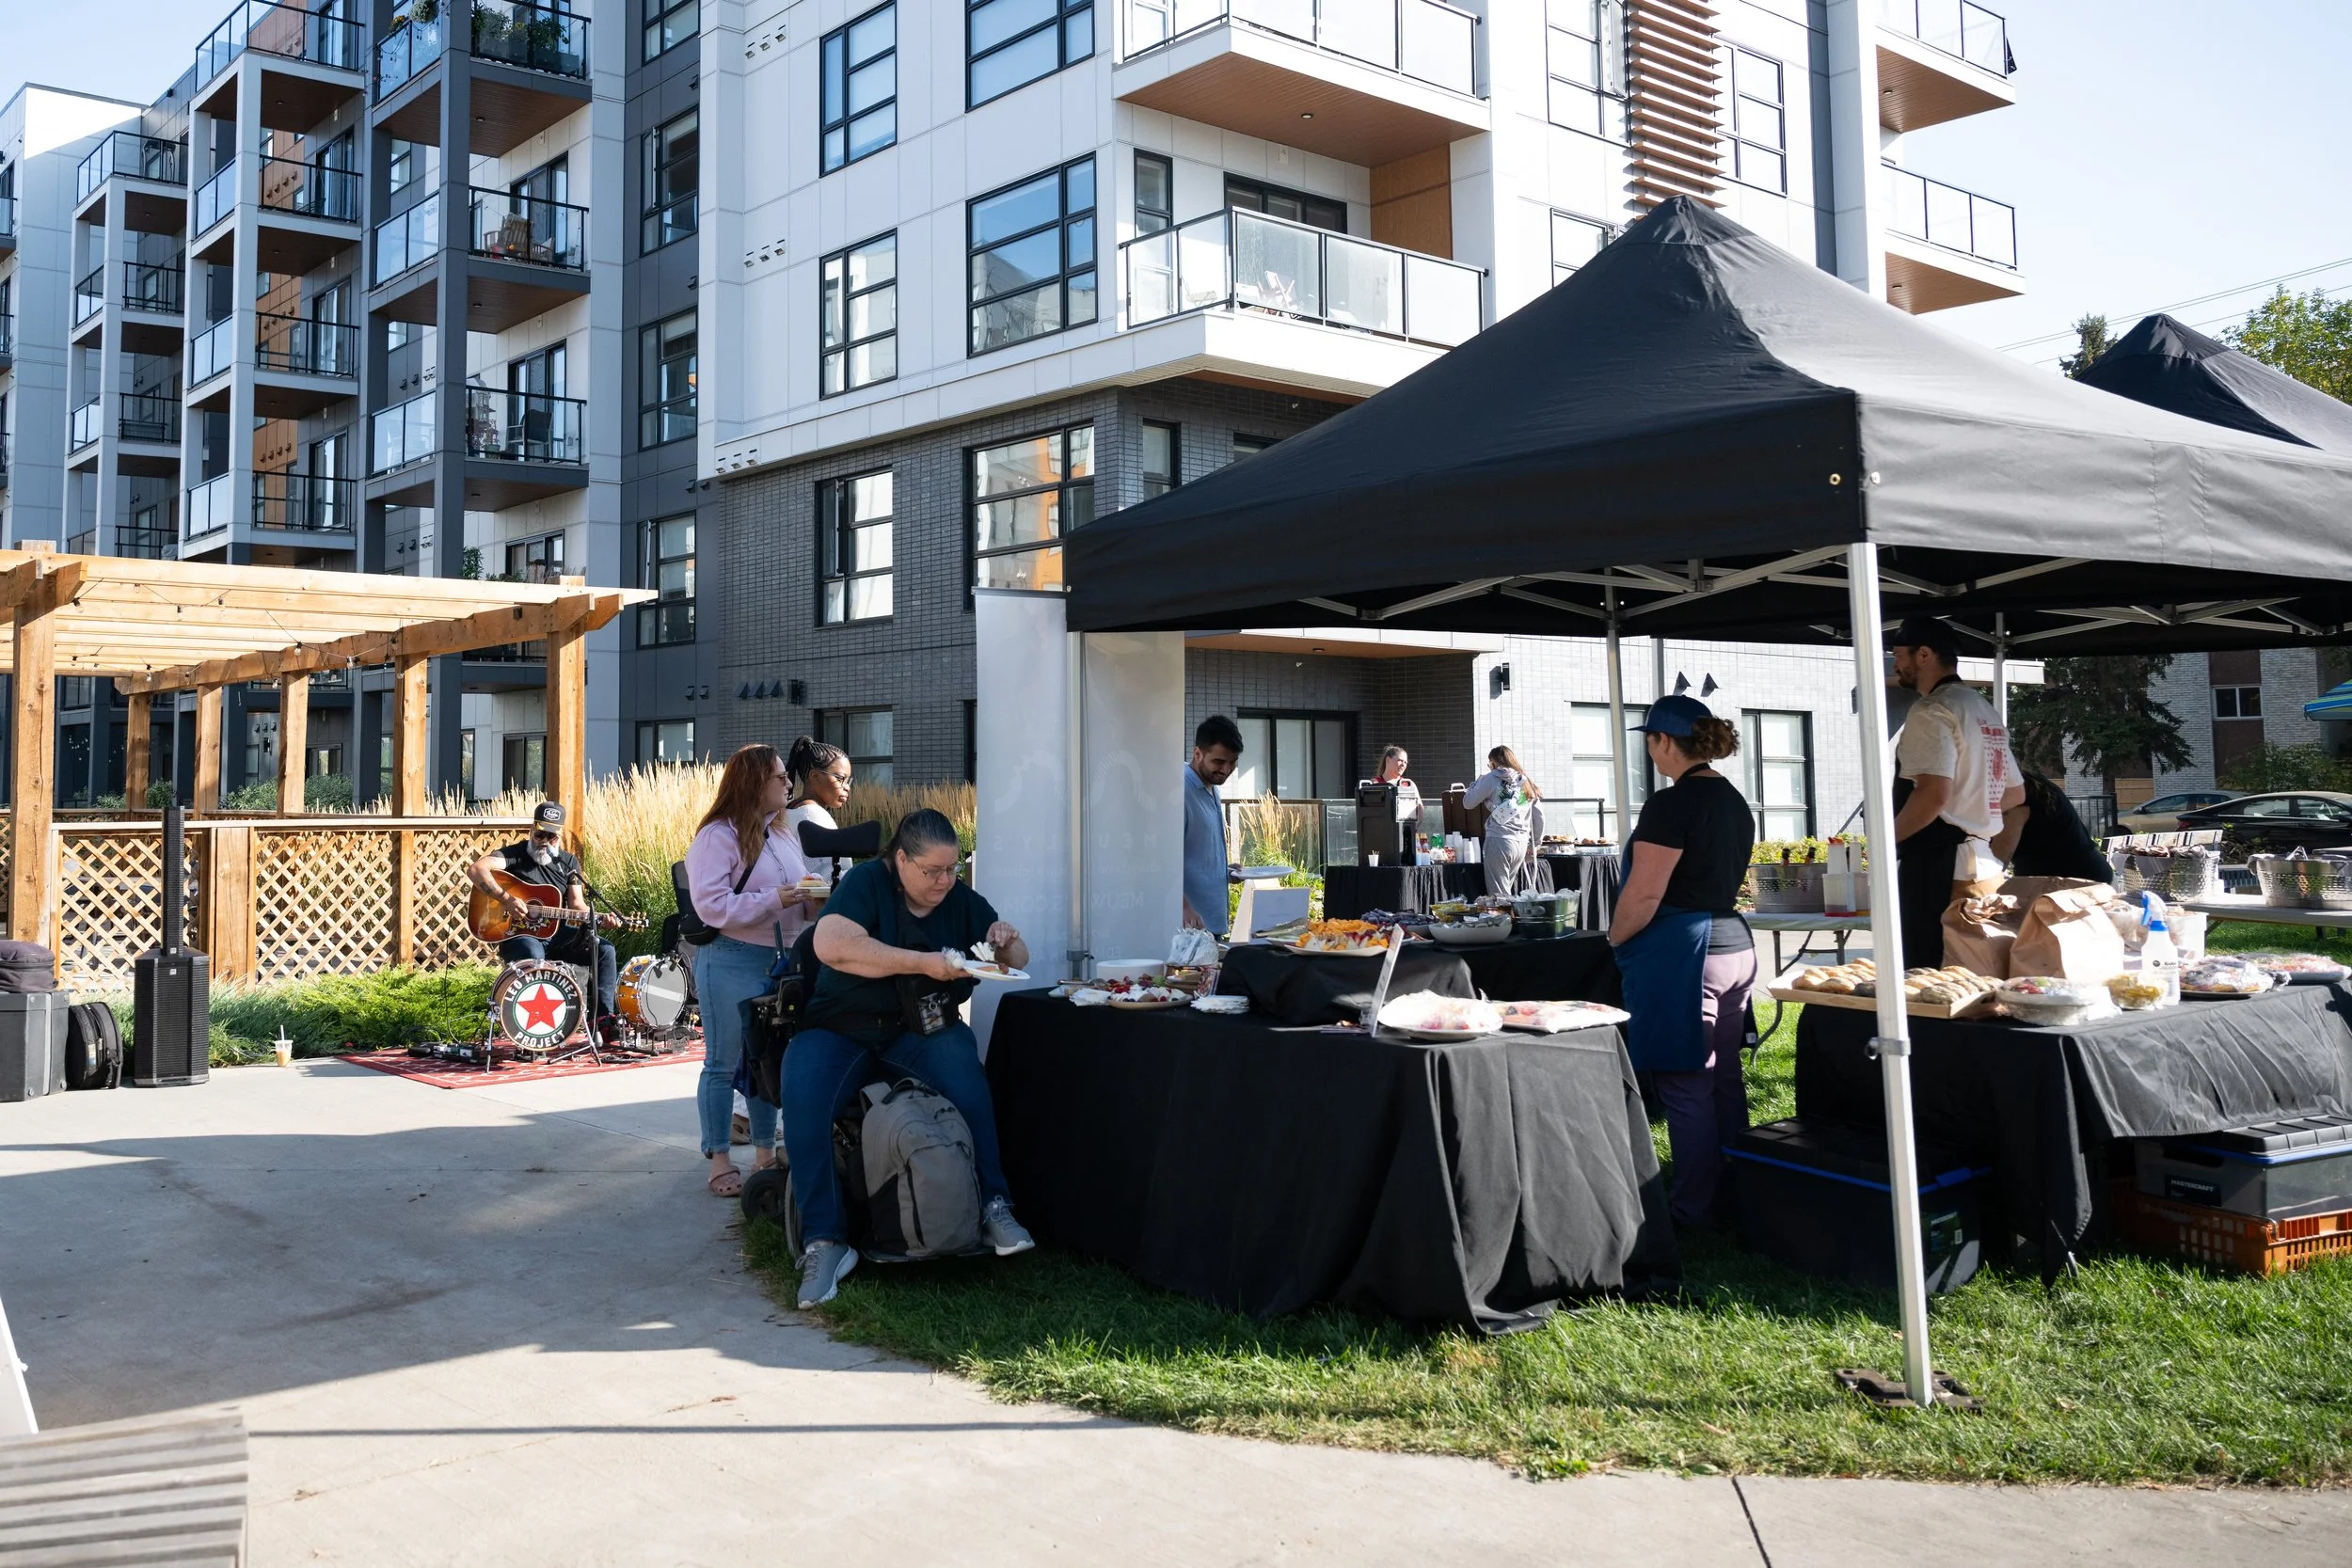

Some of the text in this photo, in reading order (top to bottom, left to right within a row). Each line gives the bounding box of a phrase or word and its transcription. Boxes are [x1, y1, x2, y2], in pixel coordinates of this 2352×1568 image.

[504, 970, 578, 1001] LEO MARTINEZ
[514, 1030, 564, 1048] PROJECT
